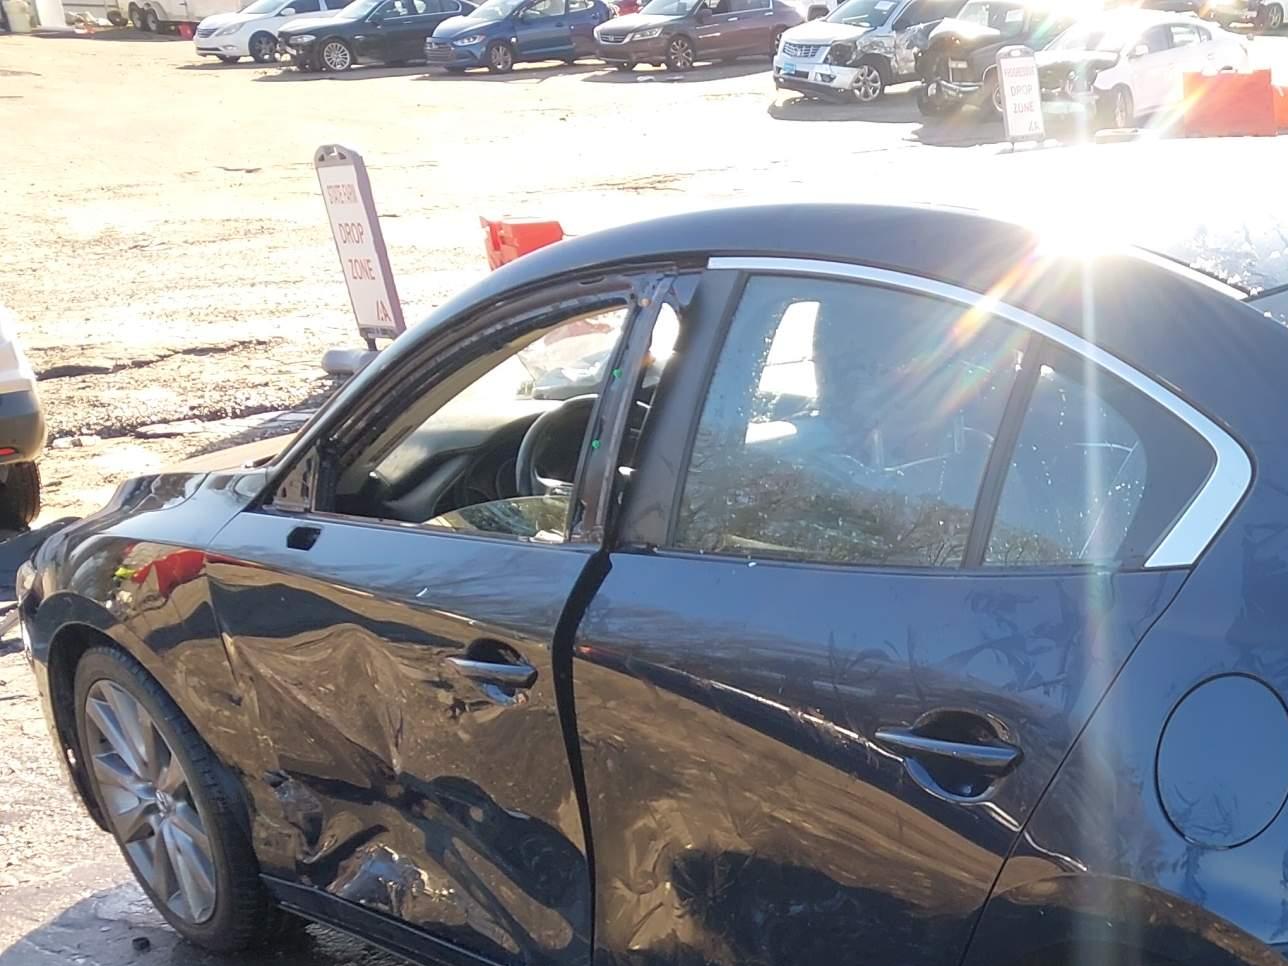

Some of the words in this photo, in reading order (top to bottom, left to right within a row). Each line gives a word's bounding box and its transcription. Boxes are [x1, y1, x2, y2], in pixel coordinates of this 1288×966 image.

[1010, 84, 1033, 97] DROP
[1012, 102, 1035, 114] ZONE
[338, 222, 365, 245] DROP
[348, 258, 376, 281] ZONE
